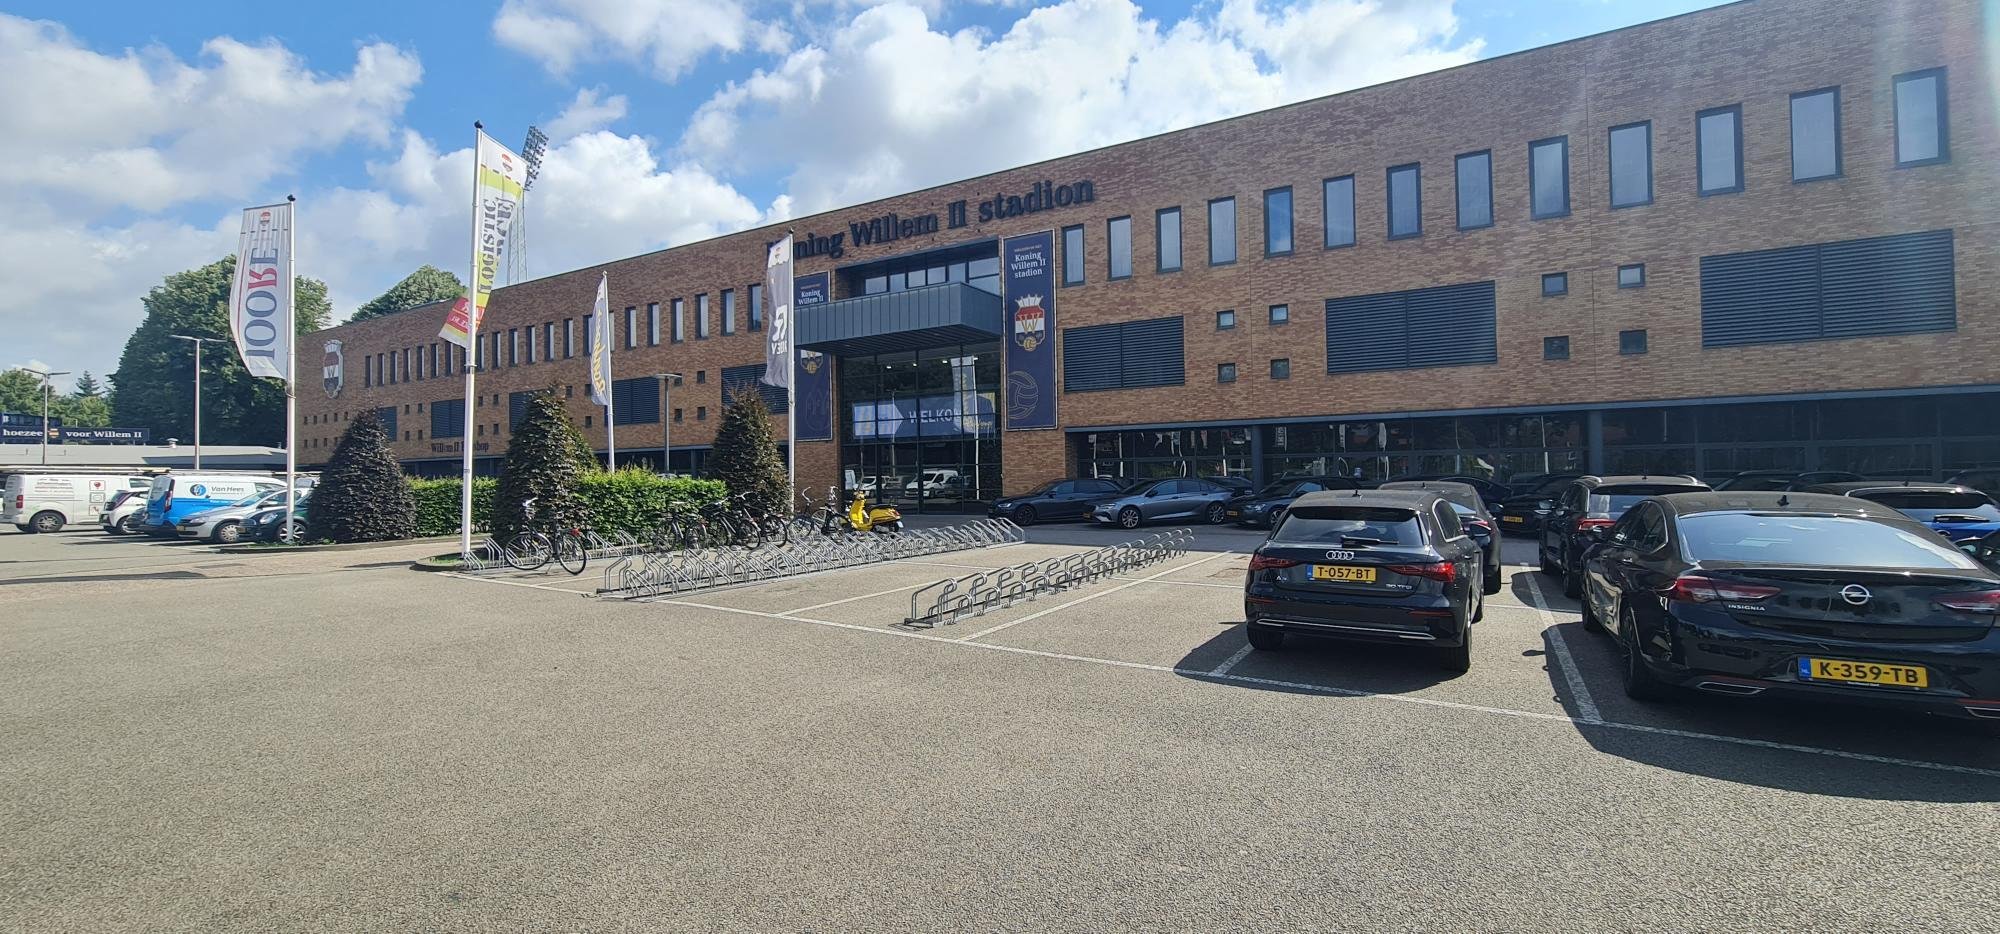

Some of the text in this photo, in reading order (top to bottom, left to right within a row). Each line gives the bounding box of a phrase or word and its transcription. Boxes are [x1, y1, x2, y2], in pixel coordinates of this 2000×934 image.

[849, 212, 938, 247] Willem
[947, 199, 968, 229] II
[978, 179, 1096, 223] stadion
[479, 199, 496, 292] LOGISTIC
[1015, 251, 1042, 262] Koning
[1011, 258, 1046, 271] Willem II
[1014, 268, 1042, 278] stadion
[801, 289, 821, 298] Koning
[798, 296, 818, 305] Willem
[3, 429, 43, 437] hoezee
[93, 430, 131, 438] Willem
[1318, 566, 1371, 580] T-057-BT
[1728, 603, 1765, 612] INSIGNIA
[1819, 662, 1918, 684] K-359-TB
